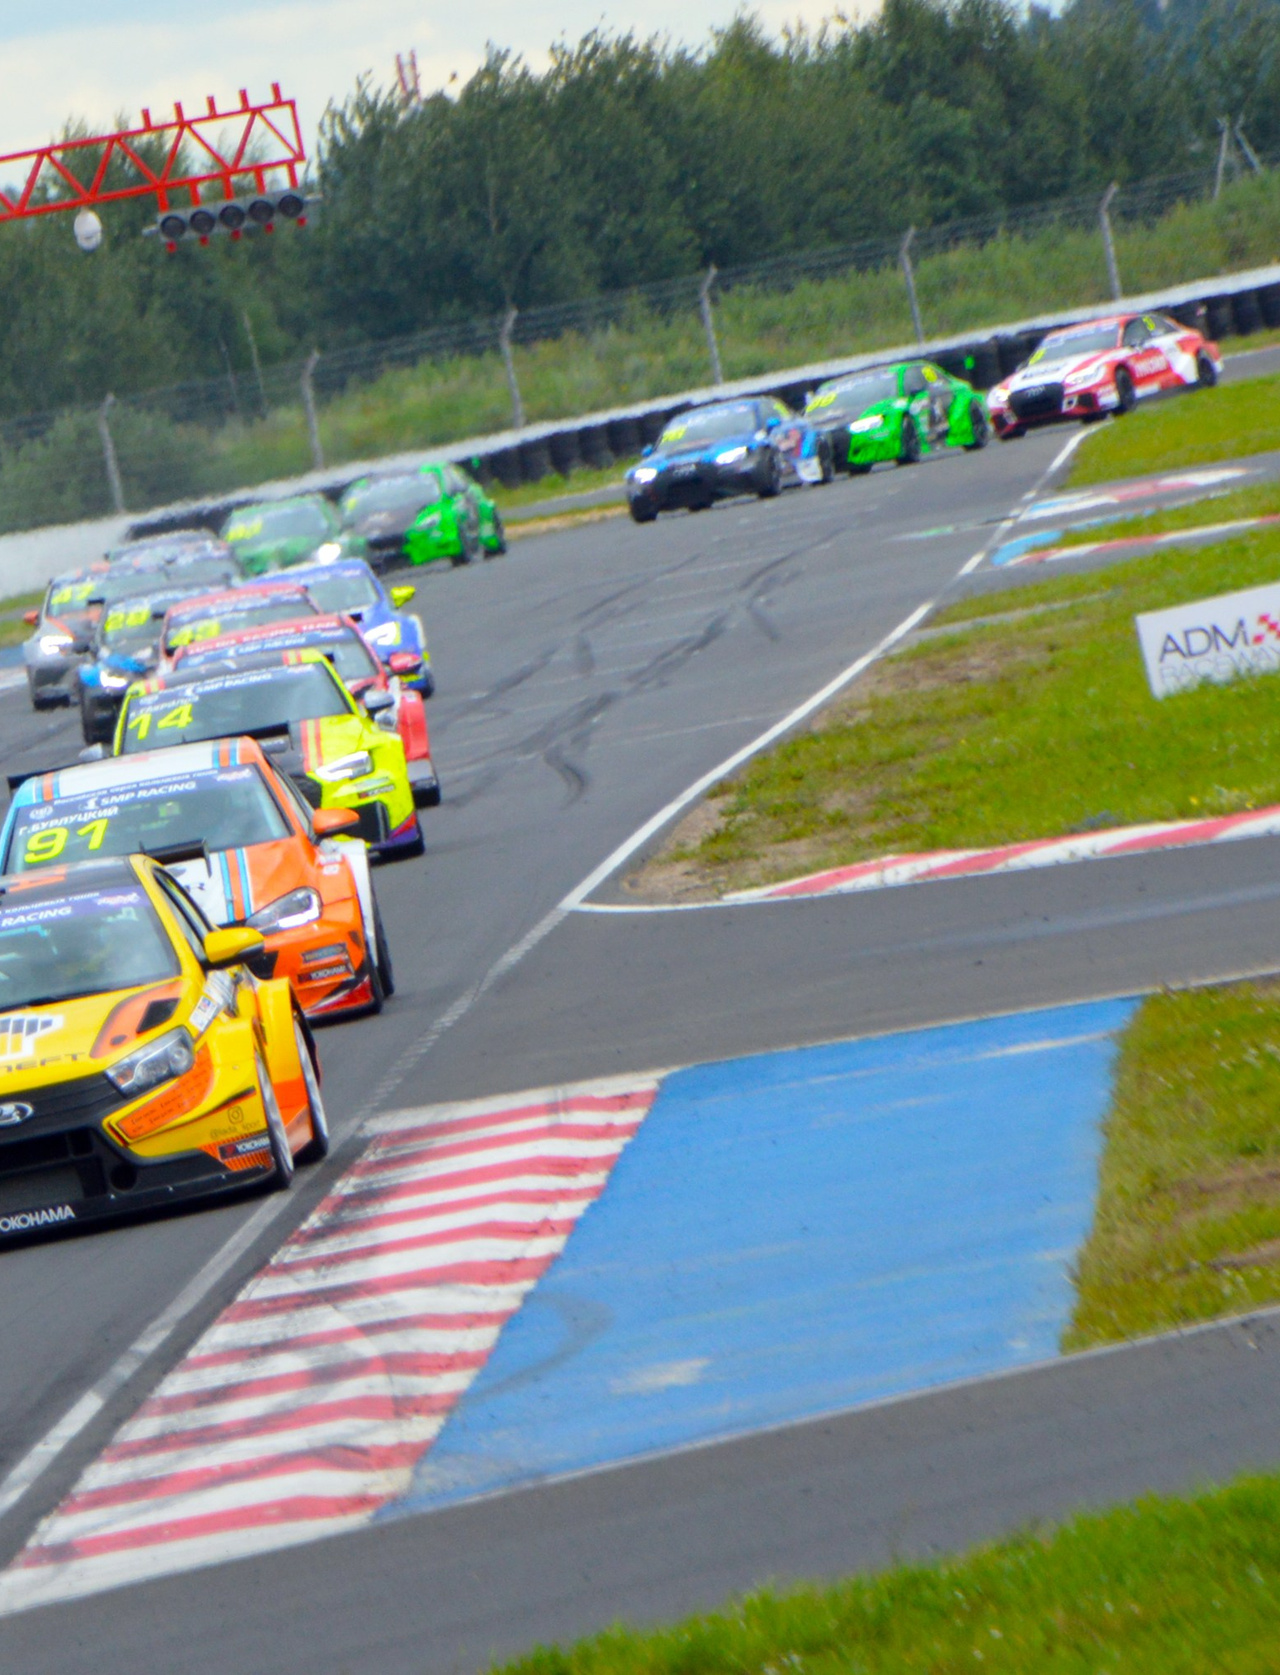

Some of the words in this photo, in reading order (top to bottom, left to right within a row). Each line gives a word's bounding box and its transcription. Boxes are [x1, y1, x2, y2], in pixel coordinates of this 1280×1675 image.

[1159, 617, 1249, 663] ADM
[127, 703, 193, 740] 14
[101, 792, 136, 807] SMP
[138, 780, 196, 798] RACING
[24, 818, 109, 864] 91
[1, 905, 72, 928] RACING
